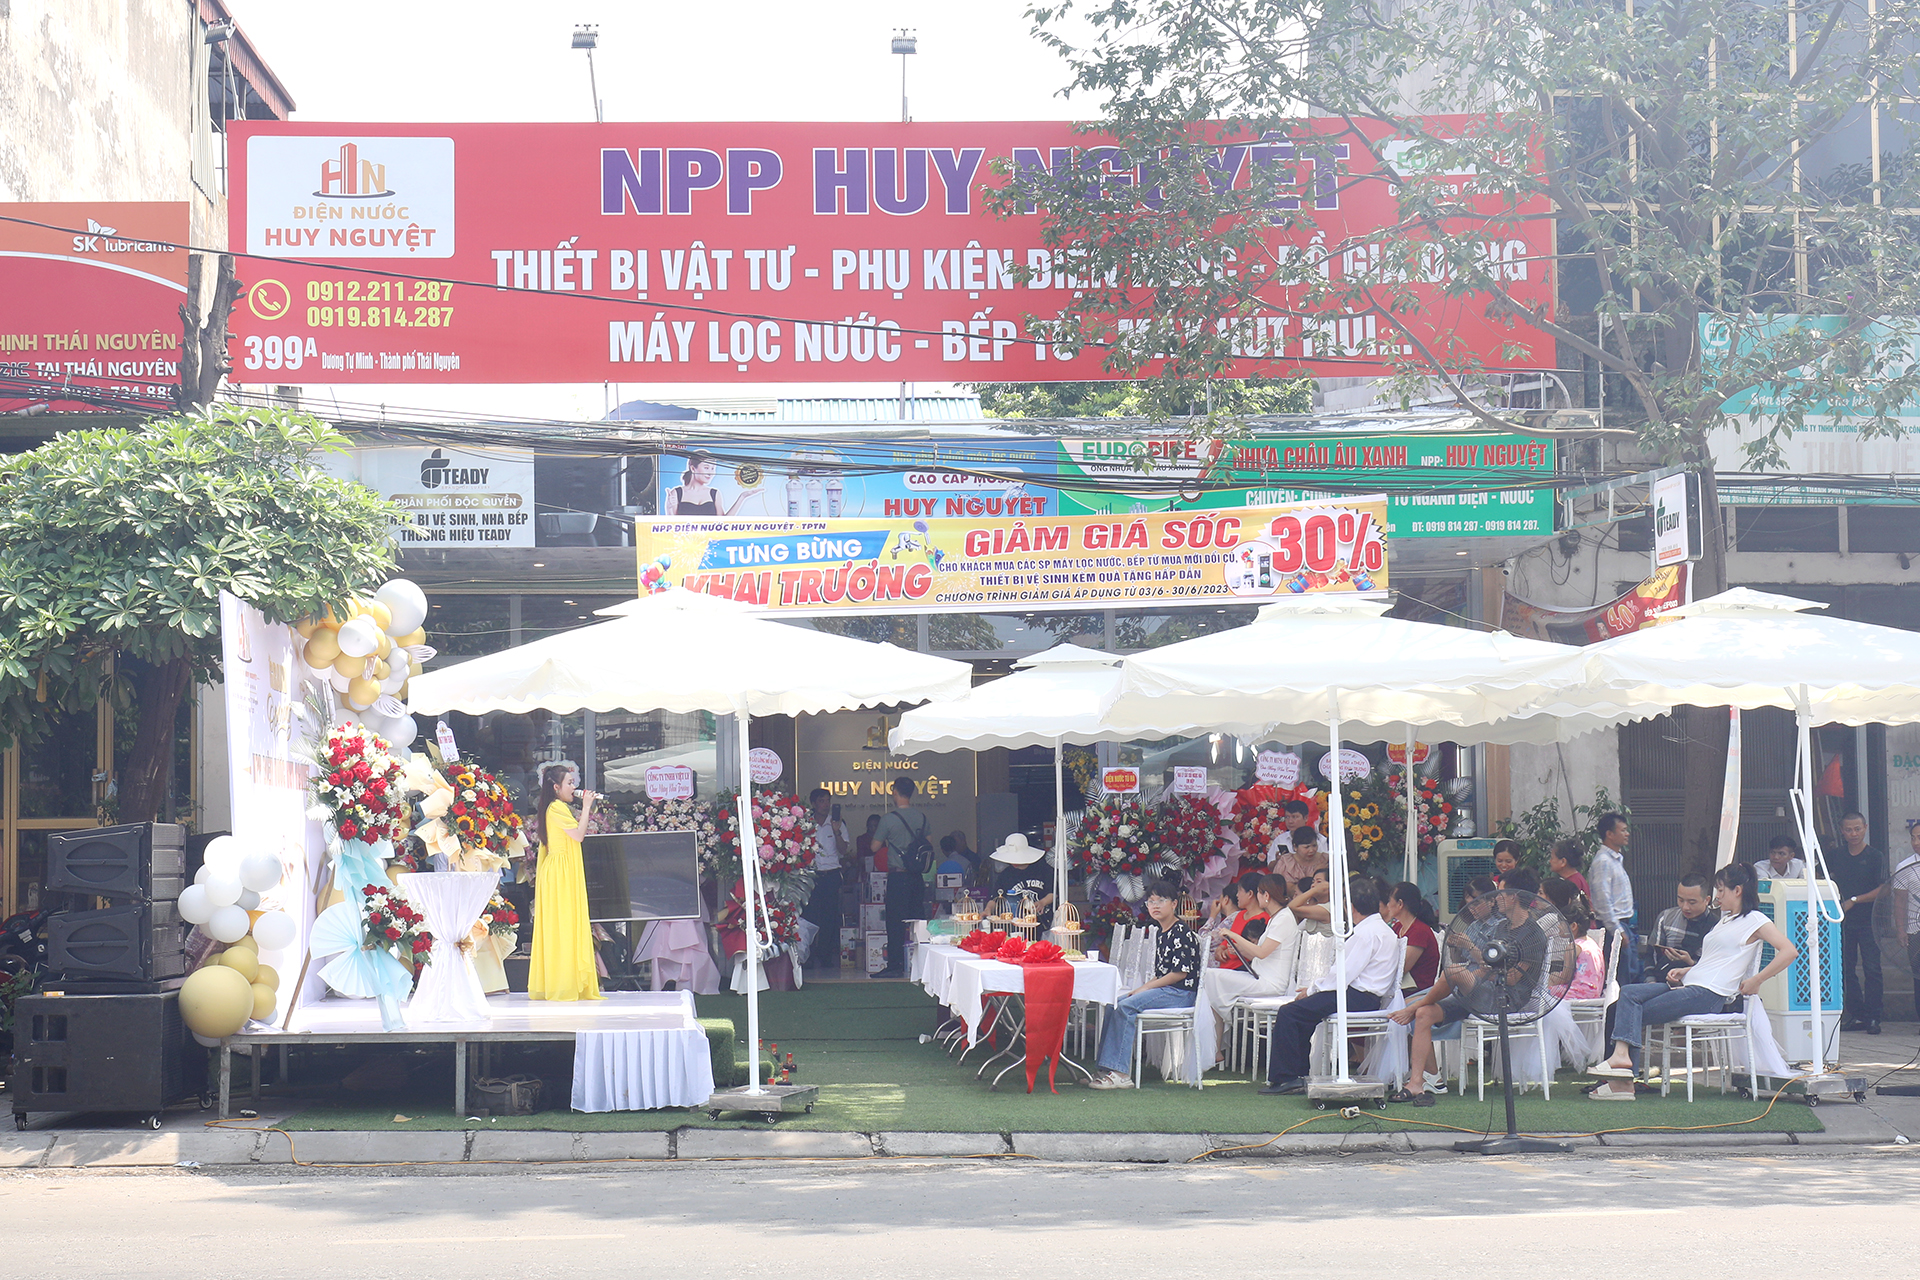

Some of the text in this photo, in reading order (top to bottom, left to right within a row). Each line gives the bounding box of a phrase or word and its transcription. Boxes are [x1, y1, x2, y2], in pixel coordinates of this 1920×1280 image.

[600, 147, 784, 215] NPP
[812, 147, 985, 215] HUY
[293, 203, 410, 223] ĐIỆN NƯỚC
[72, 234, 176, 252] SK lubricants
[265, 223, 437, 252] HUY NGUYỆT
[490, 236, 598, 292] THIẾT
[609, 249, 649, 300] BỊ
[660, 240, 733, 300] VẬT
[744, 244, 797, 291] TƯ
[804, 267, 820, 278] -
[832, 248, 911, 300] PHỤ
[923, 239, 1015, 300] KIỆN
[306, 280, 454, 302] 0912.211.287
[306, 307, 454, 328] 0919.814.287
[43, 329, 88, 351] THÁI
[96, 329, 177, 351] NGUYÊN
[608, 312, 695, 362] MÁY
[708, 320, 782, 371] LỌC
[793, 311, 902, 362] NƯỚC
[914, 338, 929, 349] -
[942, 307, 1018, 361] BẾP
[35, 361, 60, 381] TẠI
[64, 357, 103, 377] THÁI
[107, 357, 178, 377] NGUYÊN
[321, 352, 344, 372] Dương
[345, 352, 355, 373] Tự
[355, 352, 374, 370] Minh
[380, 351, 401, 370] Thành
[402, 350, 415, 371] phố
[417, 352, 432, 370] Thái
[433, 352, 460, 372] Nguyên
[1283, 441, 1329, 471] CHÂU
[1333, 441, 1357, 471] ÂU
[1361, 445, 1408, 470] XANH
[1421, 455, 1444, 468] NPP:
[1446, 445, 1479, 467] HUY
[1483, 439, 1548, 470] NGUYỆT
[442, 468, 489, 485] TEADY
[908, 474, 937, 485] CAO
[394, 496, 424, 507] PHÂN
[426, 494, 451, 507] PHỐI
[455, 496, 480, 509] ĐỘC
[884, 497, 938, 517] HUY
[432, 512, 446, 528] VỆ
[449, 513, 478, 527] SINH,
[482, 510, 504, 526] NHÀ
[508, 509, 528, 525] BẾP
[652, 525, 673, 533] NPP
[674, 522, 699, 535] ĐIỆN
[700, 521, 730, 533] NƯỚC
[731, 523, 752, 532] HUY
[754, 522, 795, 533] NGUYỆT
[801, 523, 827, 531] TPTN
[1412, 521, 1424, 532] ĐT:
[1425, 521, 1446, 532] 0919
[1447, 520, 1462, 531] 814
[1463, 520, 1479, 531] 287
[1485, 520, 1506, 531] 0919
[1507, 519, 1522, 530] 814
[1523, 519, 1540, 531] 287.
[1663, 511, 1680, 532] TEADY
[449, 527, 512, 544] HIỆU TEADY
[965, 512, 1242, 558] GIẢM GIÁ SỐC
[1271, 512, 1384, 573] 30%
[726, 536, 863, 565] TƯNG BỪNG
[939, 562, 959, 573] CHO
[960, 559, 994, 572] KHÁCH
[994, 561, 1016, 571] MUA
[1017, 558, 1036, 571] CÁC
[1038, 561, 1051, 570] SP
[1053, 557, 1074, 569] MÁY
[1075, 558, 1094, 570] LỌC
[1127, 553, 1145, 567] BẾP
[1147, 554, 1160, 566] TỪ
[1161, 556, 1182, 566] MUA
[1184, 553, 1203, 566] MỚI
[1204, 551, 1221, 564] ĐỔI
[682, 558, 933, 606] KHAI TRƯƠNG
[980, 566, 1202, 588] THIẾT BỊ VỆ SINH KÈM QUÀ TẶNG HẤP DẪN
[935, 591, 985, 603] CHƯƠNG
[987, 589, 1018, 602] TRÌNH
[1020, 587, 1049, 601] GIẢM
[1051, 587, 1071, 600] GIÁ
[1073, 586, 1088, 599] ÁP
[1089, 587, 1121, 600] DỤNG
[1124, 585, 1137, 597] TỪ
[1138, 586, 1164, 597] 03/6
[1172, 584, 1229, 597] 30/6/2023
[1607, 600, 1640, 631] 40%
[852, 757, 919, 772] ĐIỆN NƯỚC
[1892, 751, 1920, 771] ĐẶC
[820, 780, 862, 796] HUY
[1026, 879, 1045, 890] YORK
